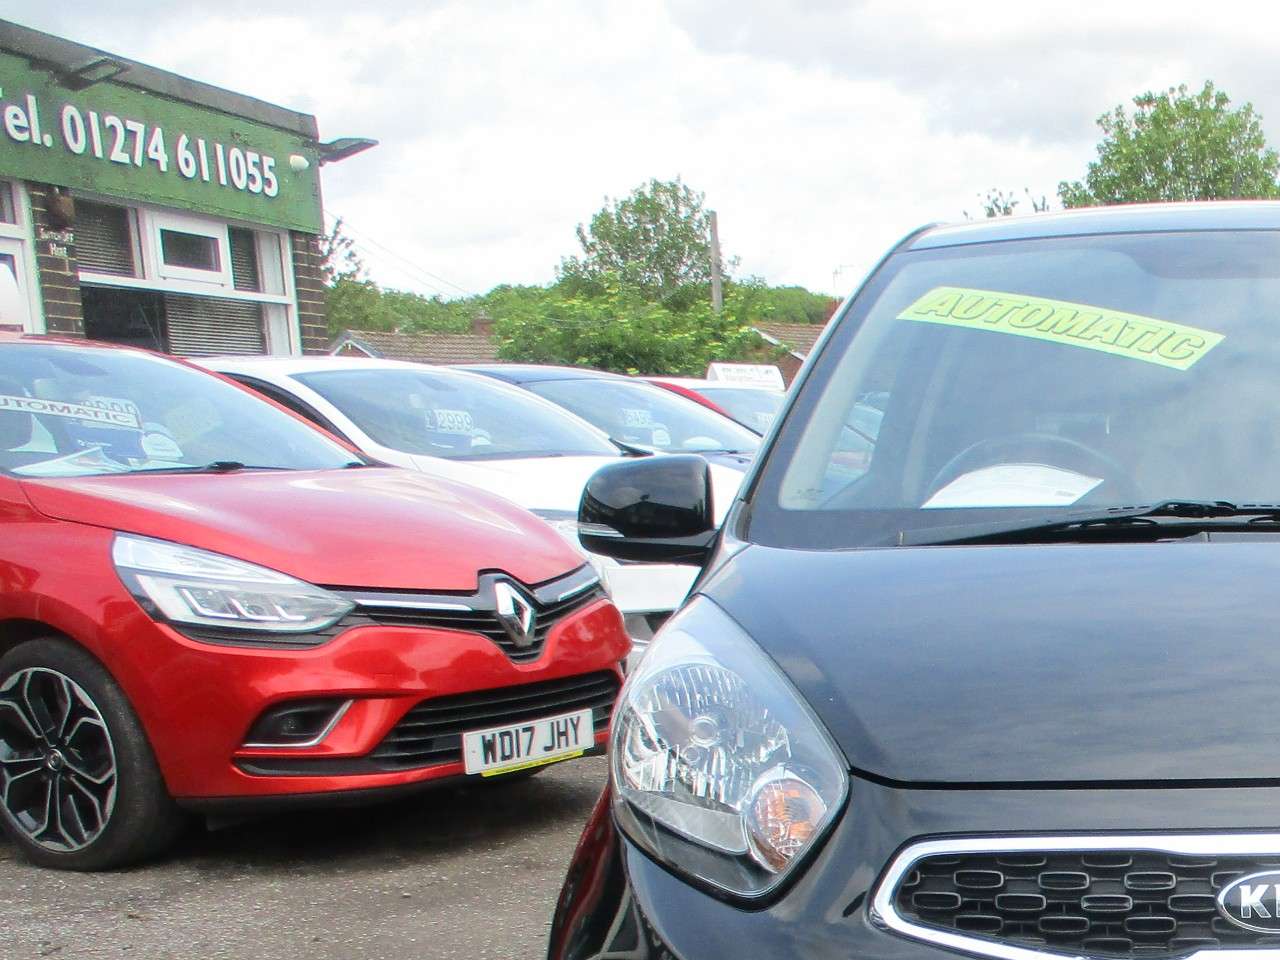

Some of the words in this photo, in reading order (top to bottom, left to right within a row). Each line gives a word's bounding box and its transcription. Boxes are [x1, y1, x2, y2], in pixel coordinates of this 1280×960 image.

[0, 88, 53, 147] el.
[61, 105, 168, 173] 01274
[177, 134, 279, 197] 611055
[914, 292, 1206, 360] AUTOMATIC
[482, 726, 535, 765] WD17
[543, 715, 580, 752] JHY
